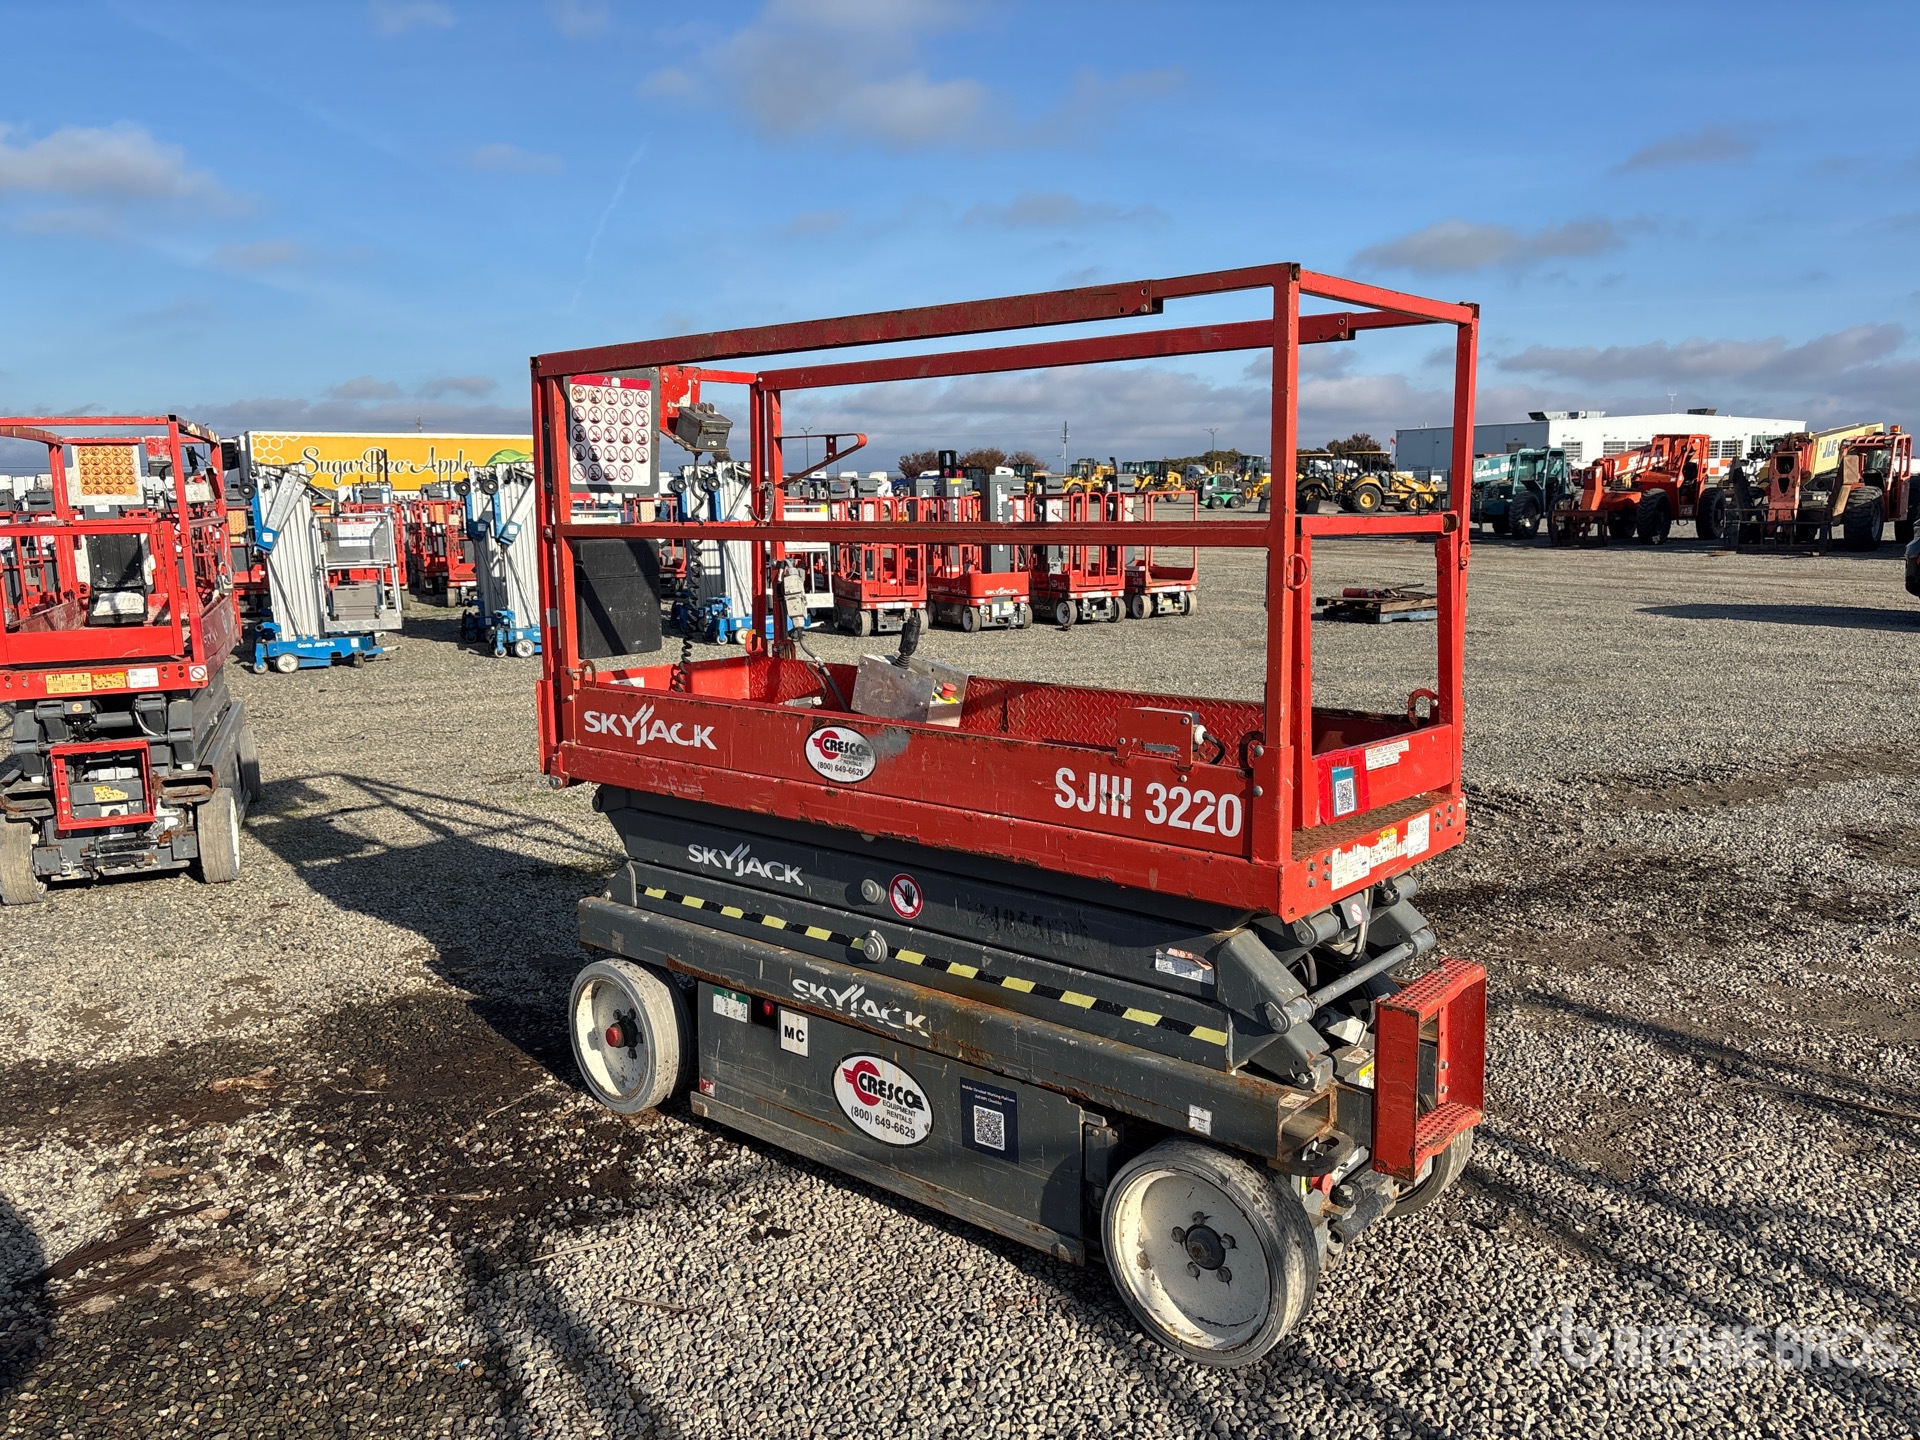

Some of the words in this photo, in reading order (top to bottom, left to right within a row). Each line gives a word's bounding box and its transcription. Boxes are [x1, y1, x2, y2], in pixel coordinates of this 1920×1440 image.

[1823, 440, 1837, 458] JLG
[410, 447, 473, 482] Apple
[985, 587, 1019, 595] SKYJACK
[584, 703, 718, 750] SKYJACK
[823, 738, 871, 757] CRESCO
[817, 761, 833, 772] (800)
[834, 764, 864, 777] 649-6629
[1145, 783, 1242, 838] 3220
[688, 842, 804, 886] SKYJACK
[792, 978, 930, 1038] SKYJACK
[784, 1025, 805, 1043] MC
[858, 1073, 925, 1111] CRESCO
[882, 1099, 917, 1117] EQUIPMENT
[886, 1110, 913, 1125] RENTALS
[850, 1105, 873, 1125] (800)
[874, 1115, 916, 1139] 649-6629
